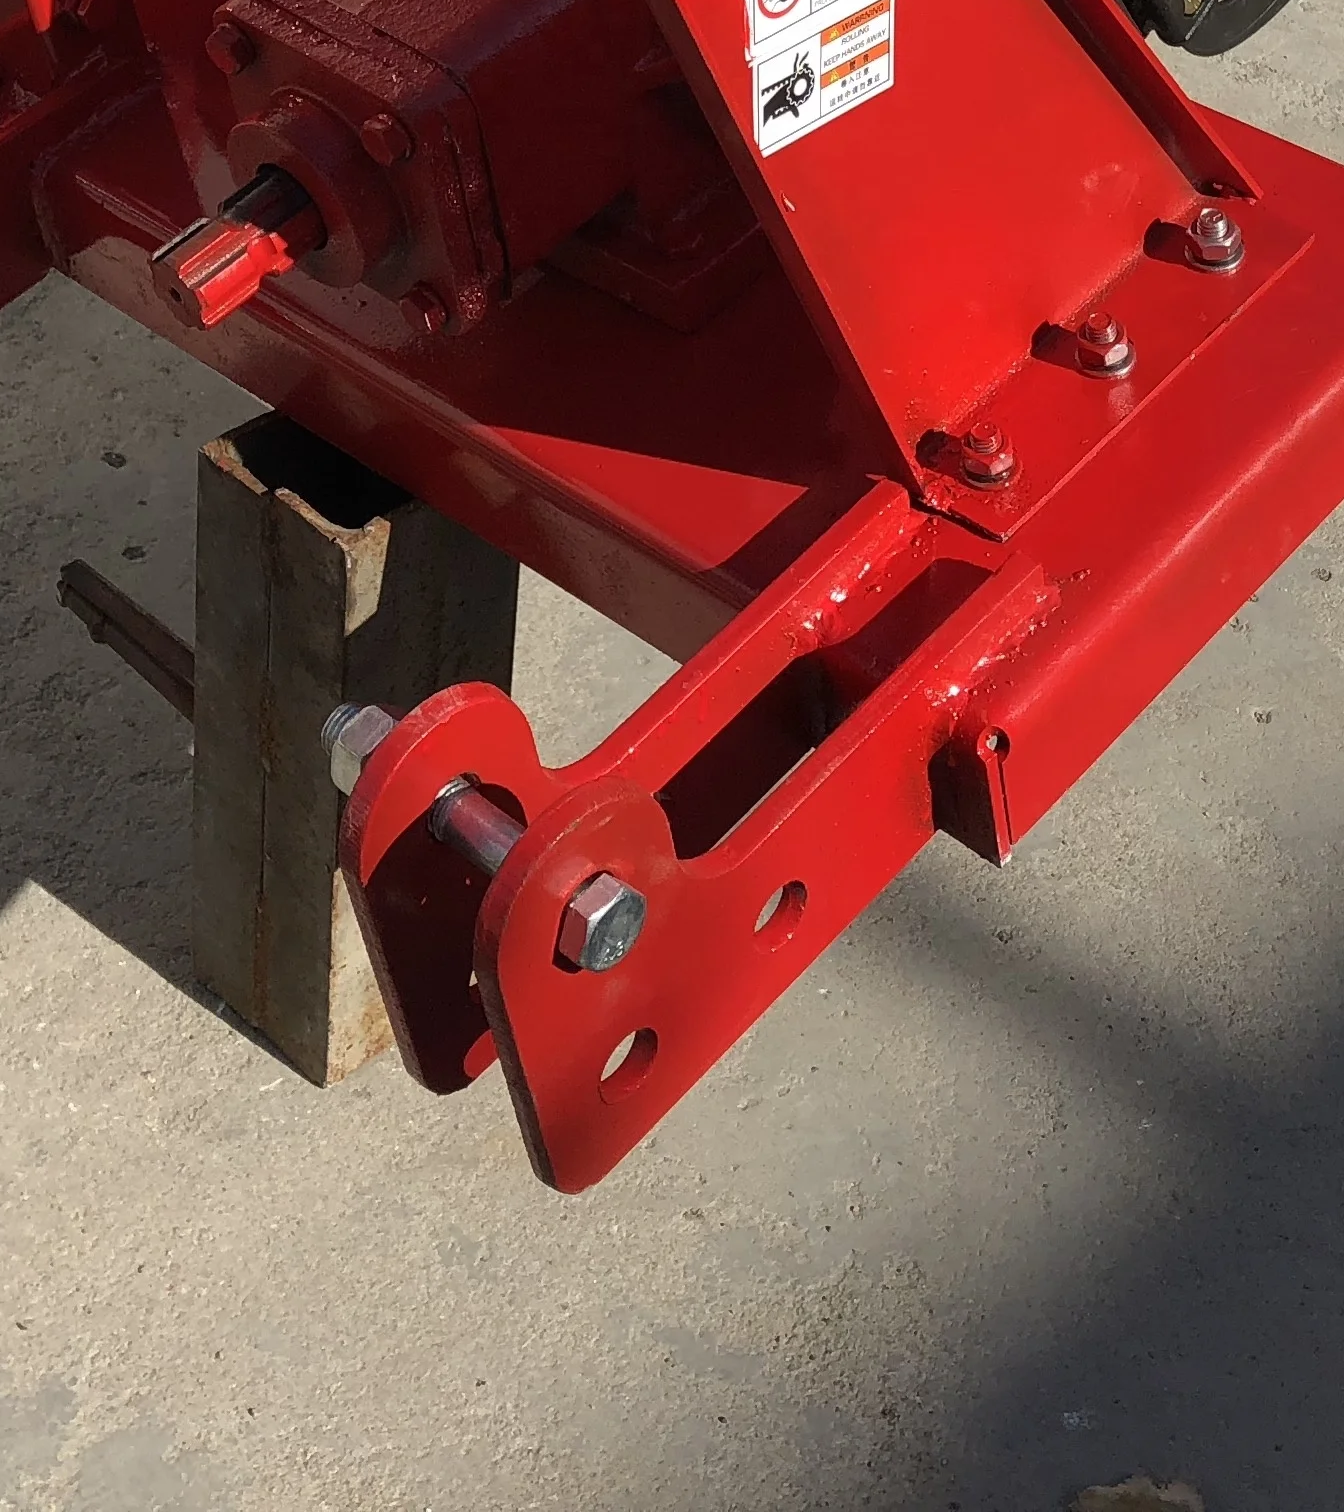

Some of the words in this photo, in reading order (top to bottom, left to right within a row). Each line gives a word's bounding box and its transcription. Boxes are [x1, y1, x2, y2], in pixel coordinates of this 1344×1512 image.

[823, 53, 841, 68] KEEP
[841, 40, 865, 57] HANDS
[866, 28, 886, 44] AWAY
[841, 25, 870, 45] ROLLING
